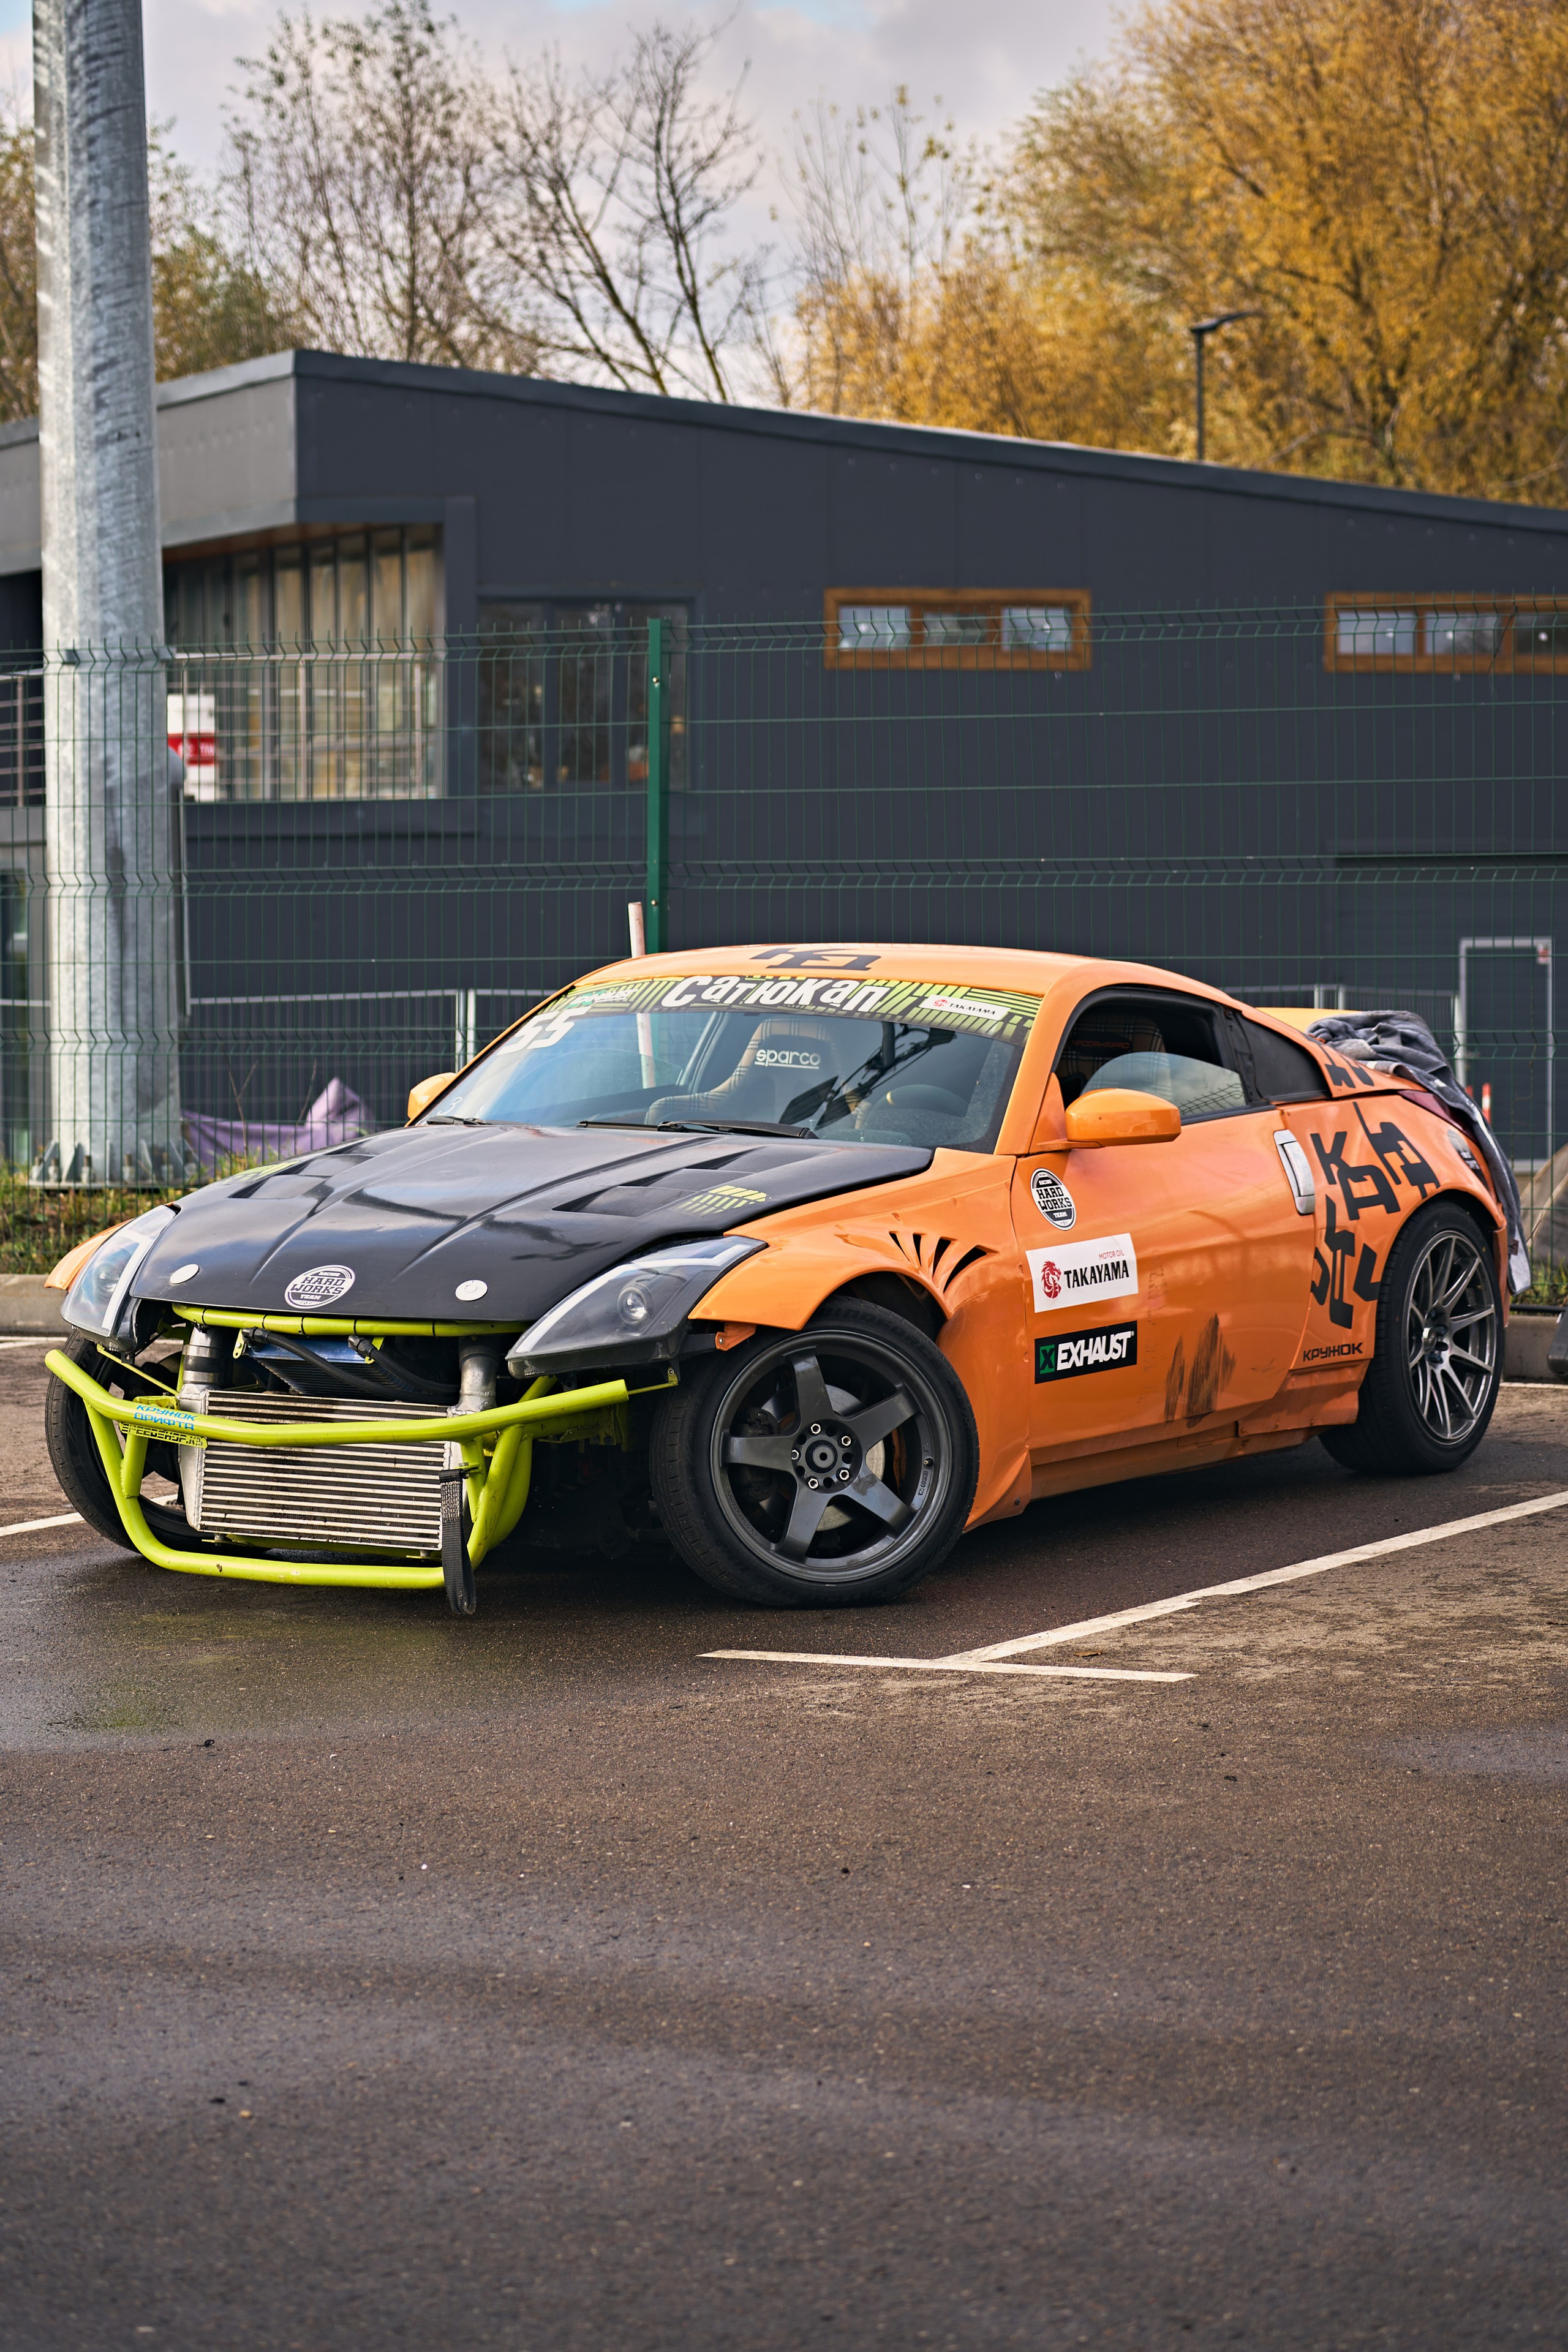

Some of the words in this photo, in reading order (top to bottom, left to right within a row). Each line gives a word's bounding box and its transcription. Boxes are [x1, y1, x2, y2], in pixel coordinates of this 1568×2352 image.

[949, 1003, 996, 1015] TAKAYAMA
[496, 1006, 592, 1056] 55
[756, 1049, 821, 1067] sparco
[1036, 1186, 1064, 1199] HARD
[1038, 1197, 1072, 1210] WORKS
[1098, 1251, 1115, 1260] MOTOR
[301, 1277, 345, 1286] HARD
[1064, 1259, 1129, 1289] TAKAYAMA
[290, 1284, 344, 1295] WORKS
[1057, 1330, 1131, 1371] EXHAUST
[1303, 1342, 1363, 1362] КРУЖОК
[134, 1412, 195, 1430] ДРИФТА
[136, 1404, 198, 1421] КРУЖОК
